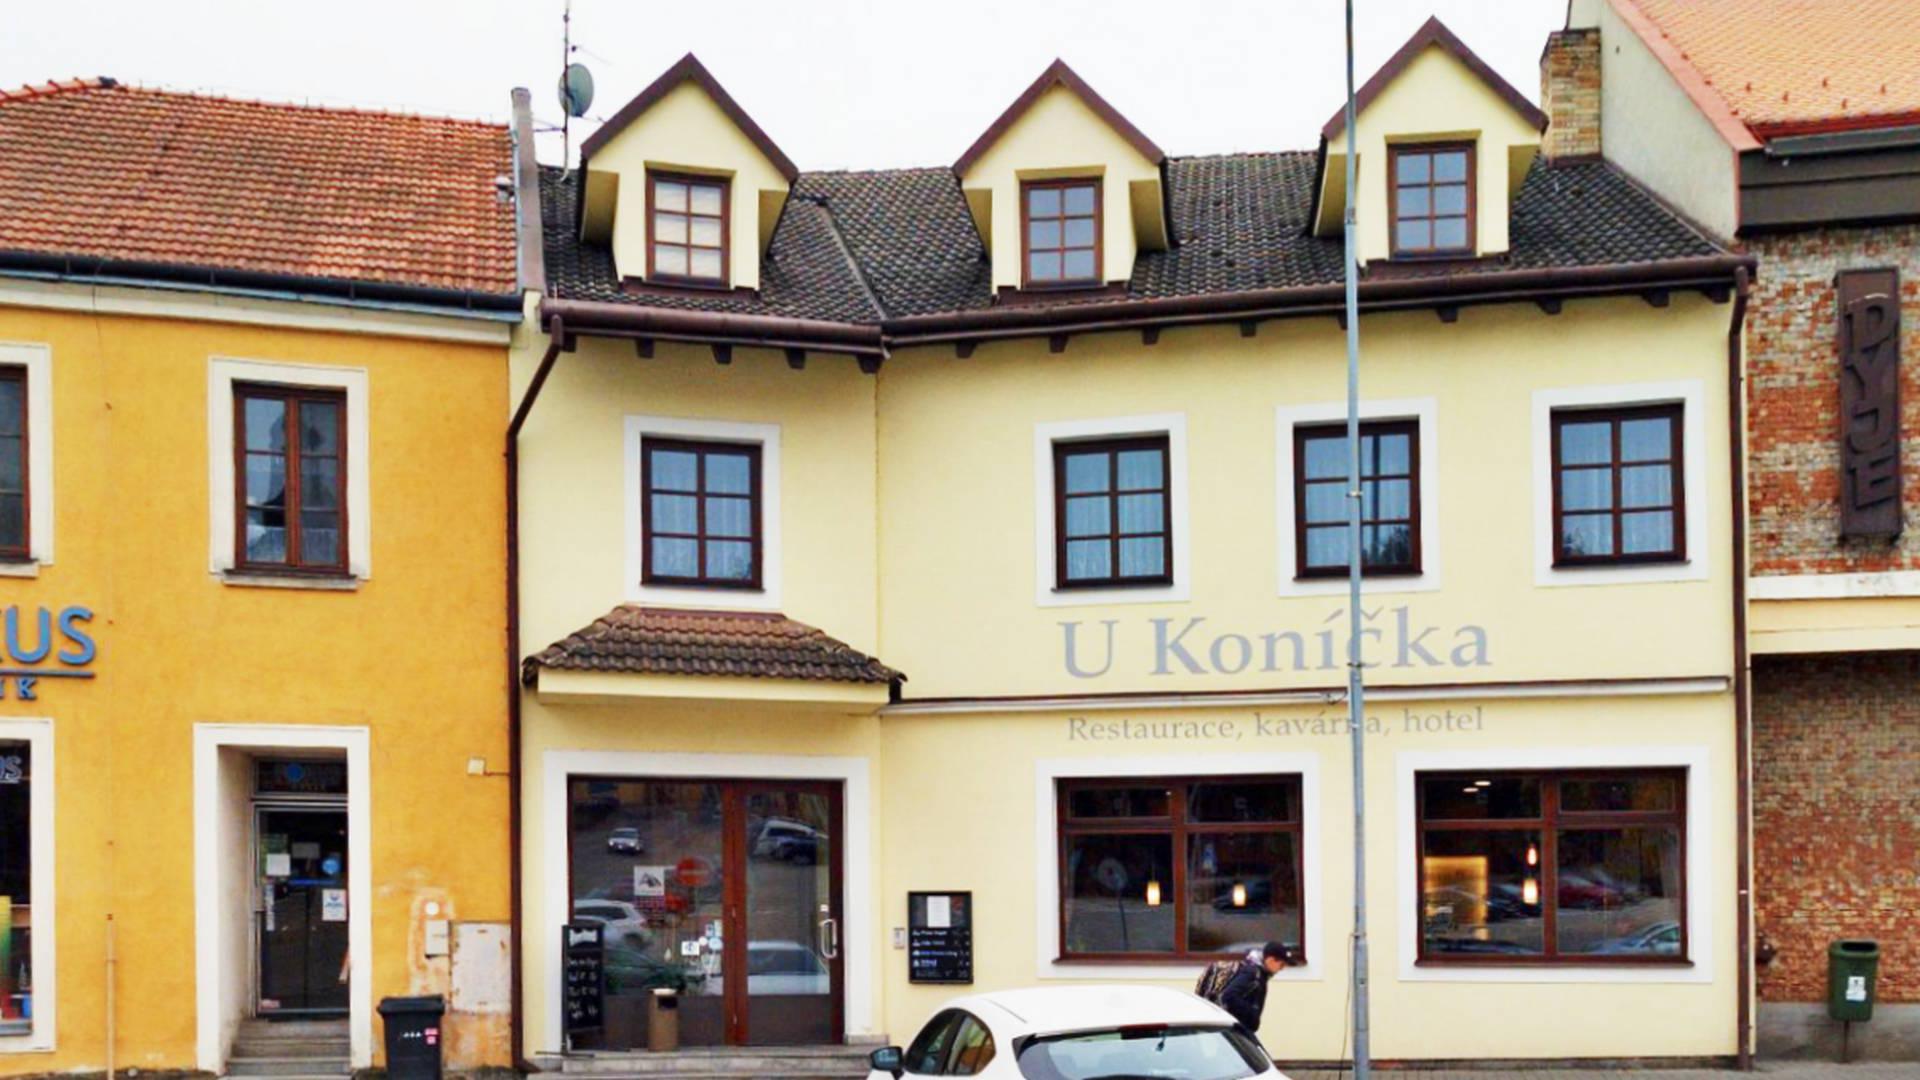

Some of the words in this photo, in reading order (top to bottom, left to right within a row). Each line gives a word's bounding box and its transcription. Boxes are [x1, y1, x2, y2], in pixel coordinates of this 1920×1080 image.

[1843, 295, 1897, 511] DYJE
[0, 606, 96, 665] US
[1057, 620, 1120, 679] U
[1148, 605, 1493, 676] Koníčka
[1068, 714, 1243, 741] Restaurace,
[1403, 706, 1483, 733] hotel
